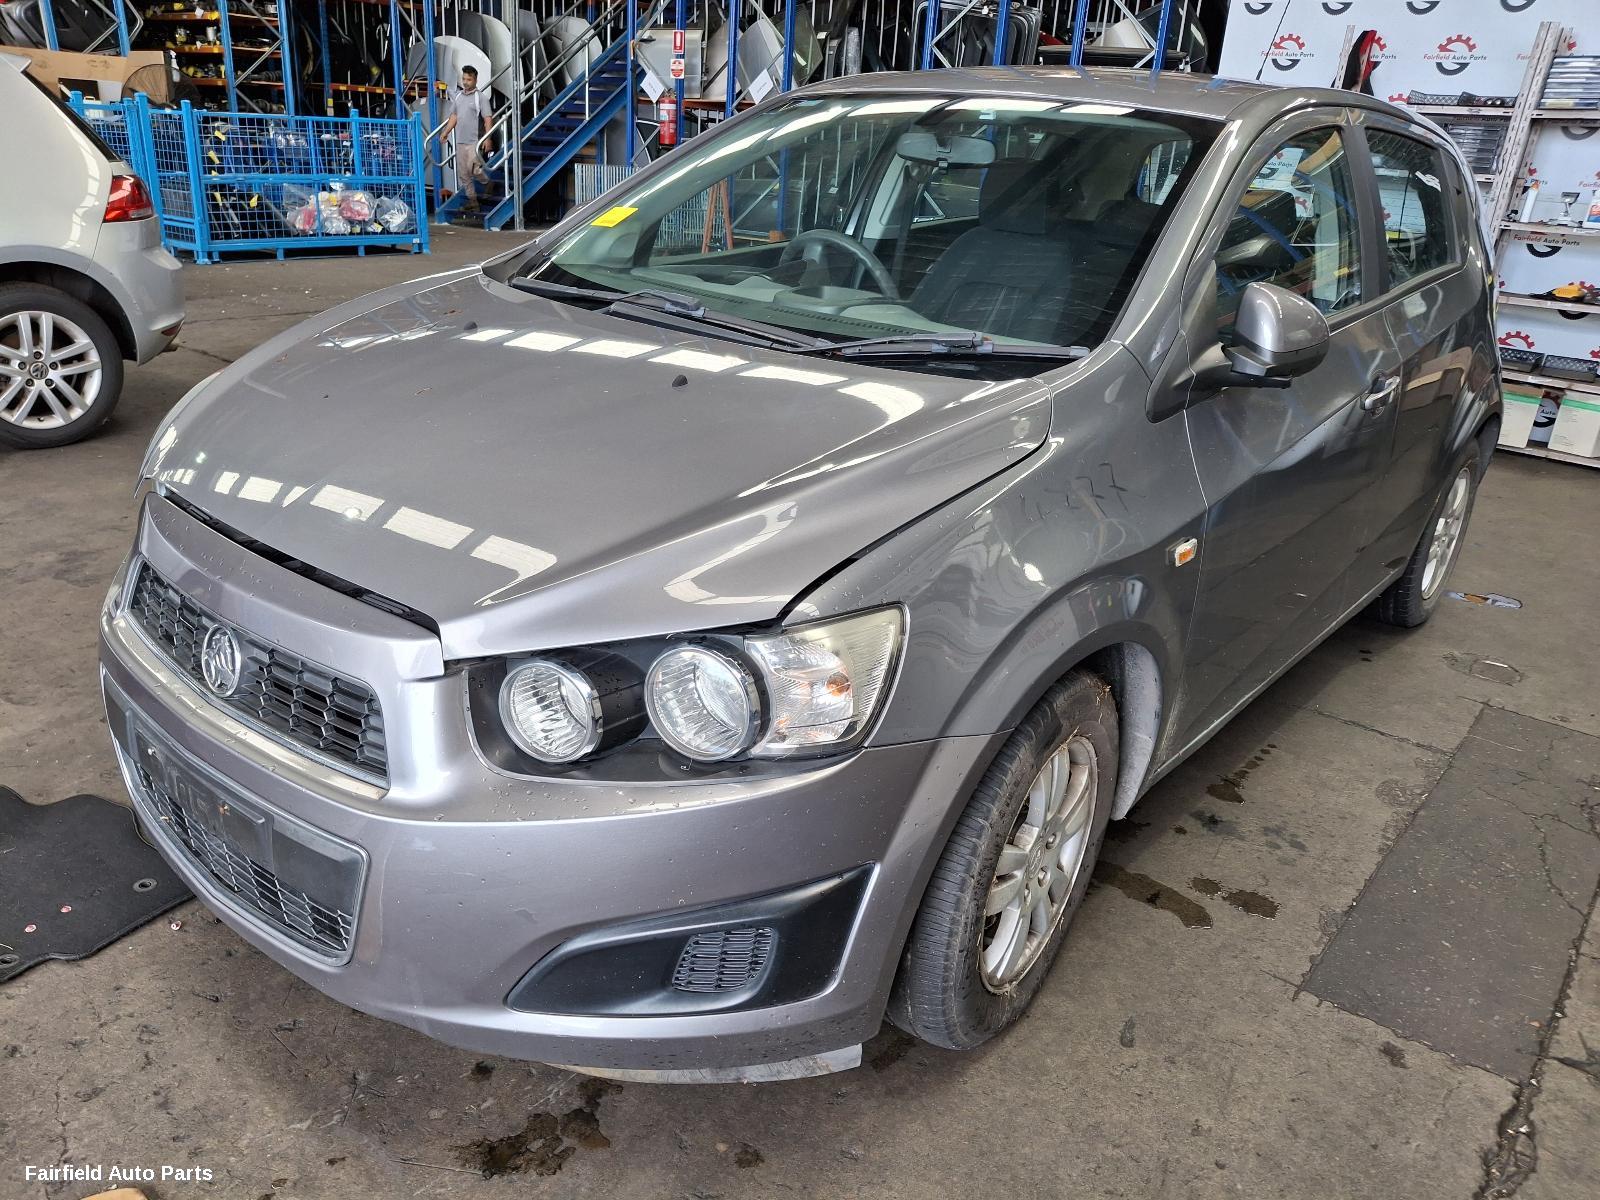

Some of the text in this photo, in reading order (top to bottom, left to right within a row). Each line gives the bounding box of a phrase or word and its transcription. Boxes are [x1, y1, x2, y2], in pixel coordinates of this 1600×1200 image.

[1423, 53, 1451, 61] Fairfield
[1513, 233, 1543, 243] Fairfield
[1560, 238, 1580, 246] Parts
